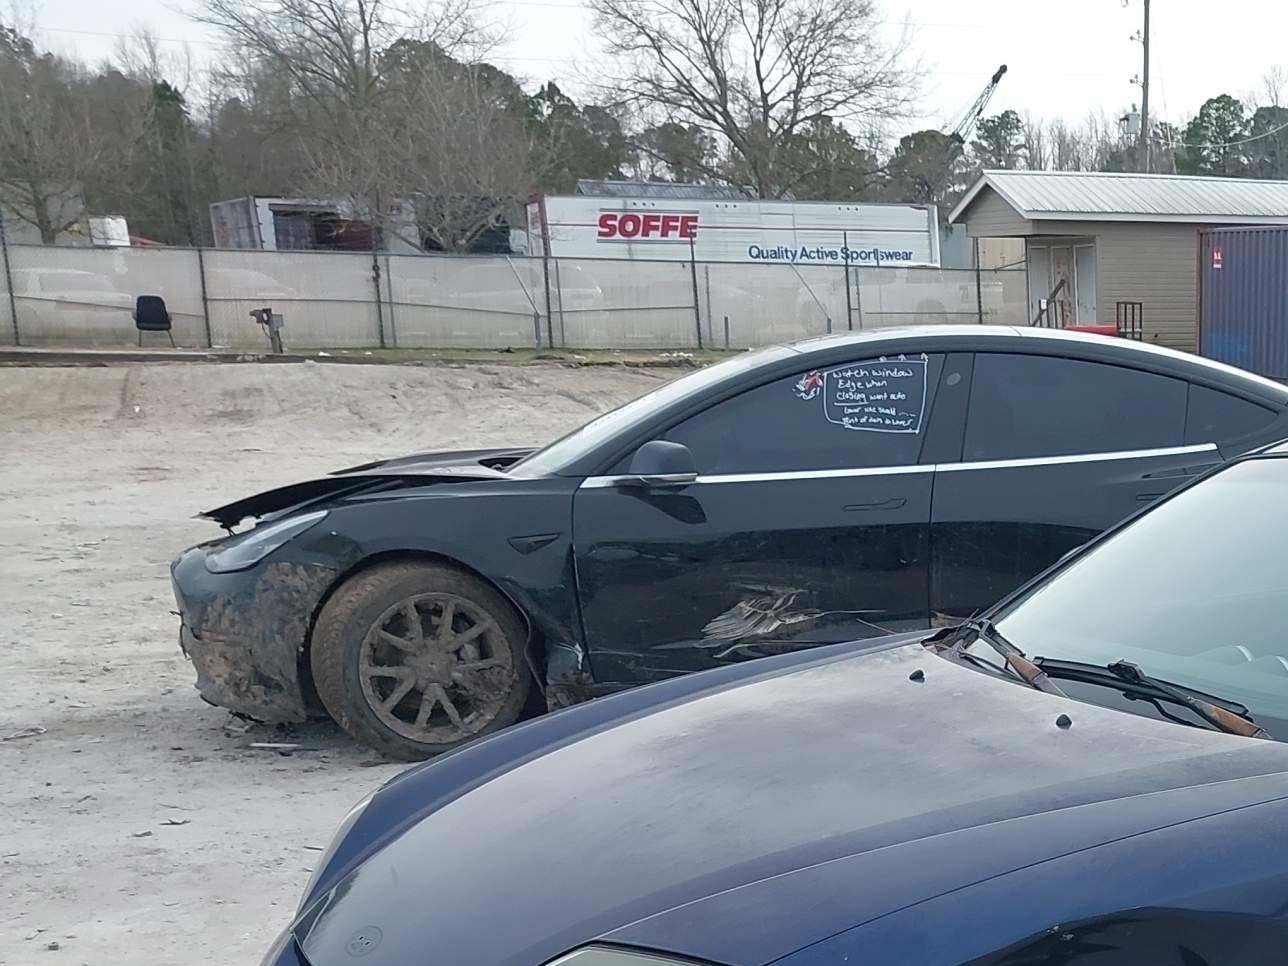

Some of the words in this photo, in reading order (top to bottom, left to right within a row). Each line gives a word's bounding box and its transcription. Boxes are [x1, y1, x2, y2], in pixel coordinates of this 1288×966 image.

[597, 213, 699, 238] SOFFE
[748, 244, 798, 262] Quality
[800, 246, 839, 260] Active
[840, 246, 914, 262] Sportswear
